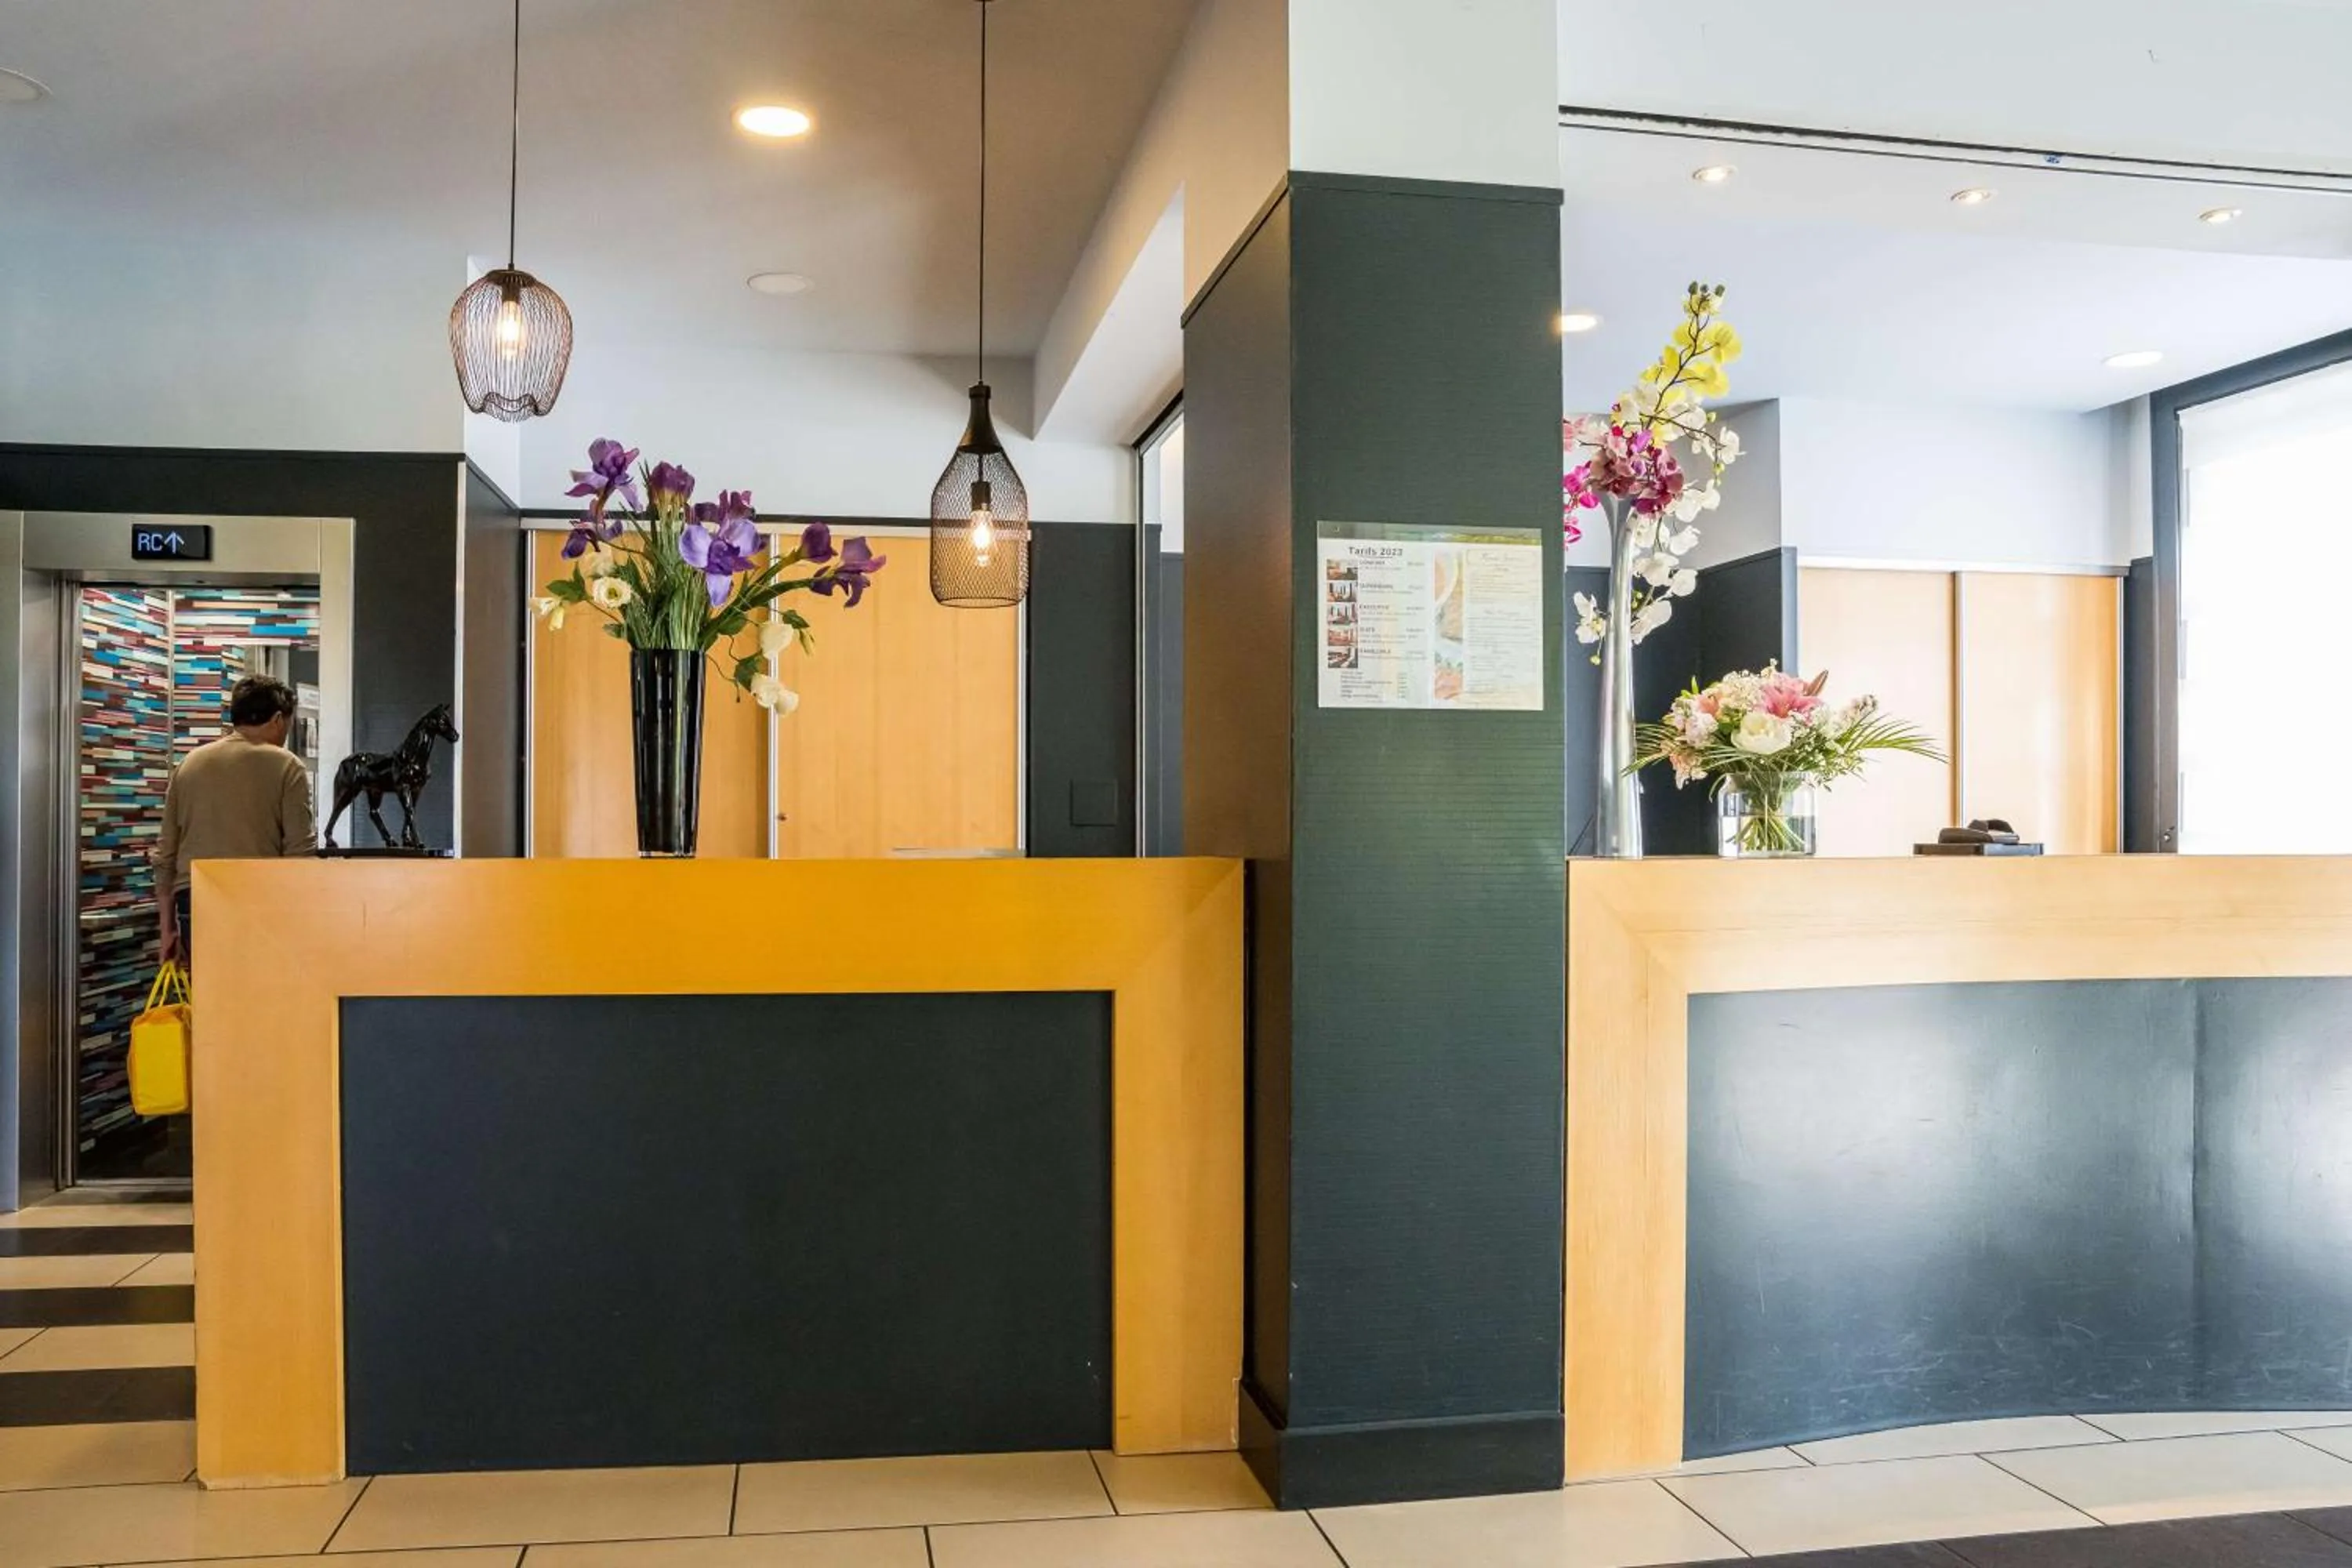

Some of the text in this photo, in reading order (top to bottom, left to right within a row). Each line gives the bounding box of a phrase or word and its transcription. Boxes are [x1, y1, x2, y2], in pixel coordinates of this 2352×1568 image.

[137, 533, 163, 551] RC
[1348, 546, 1403, 557] Tarifs 2023
